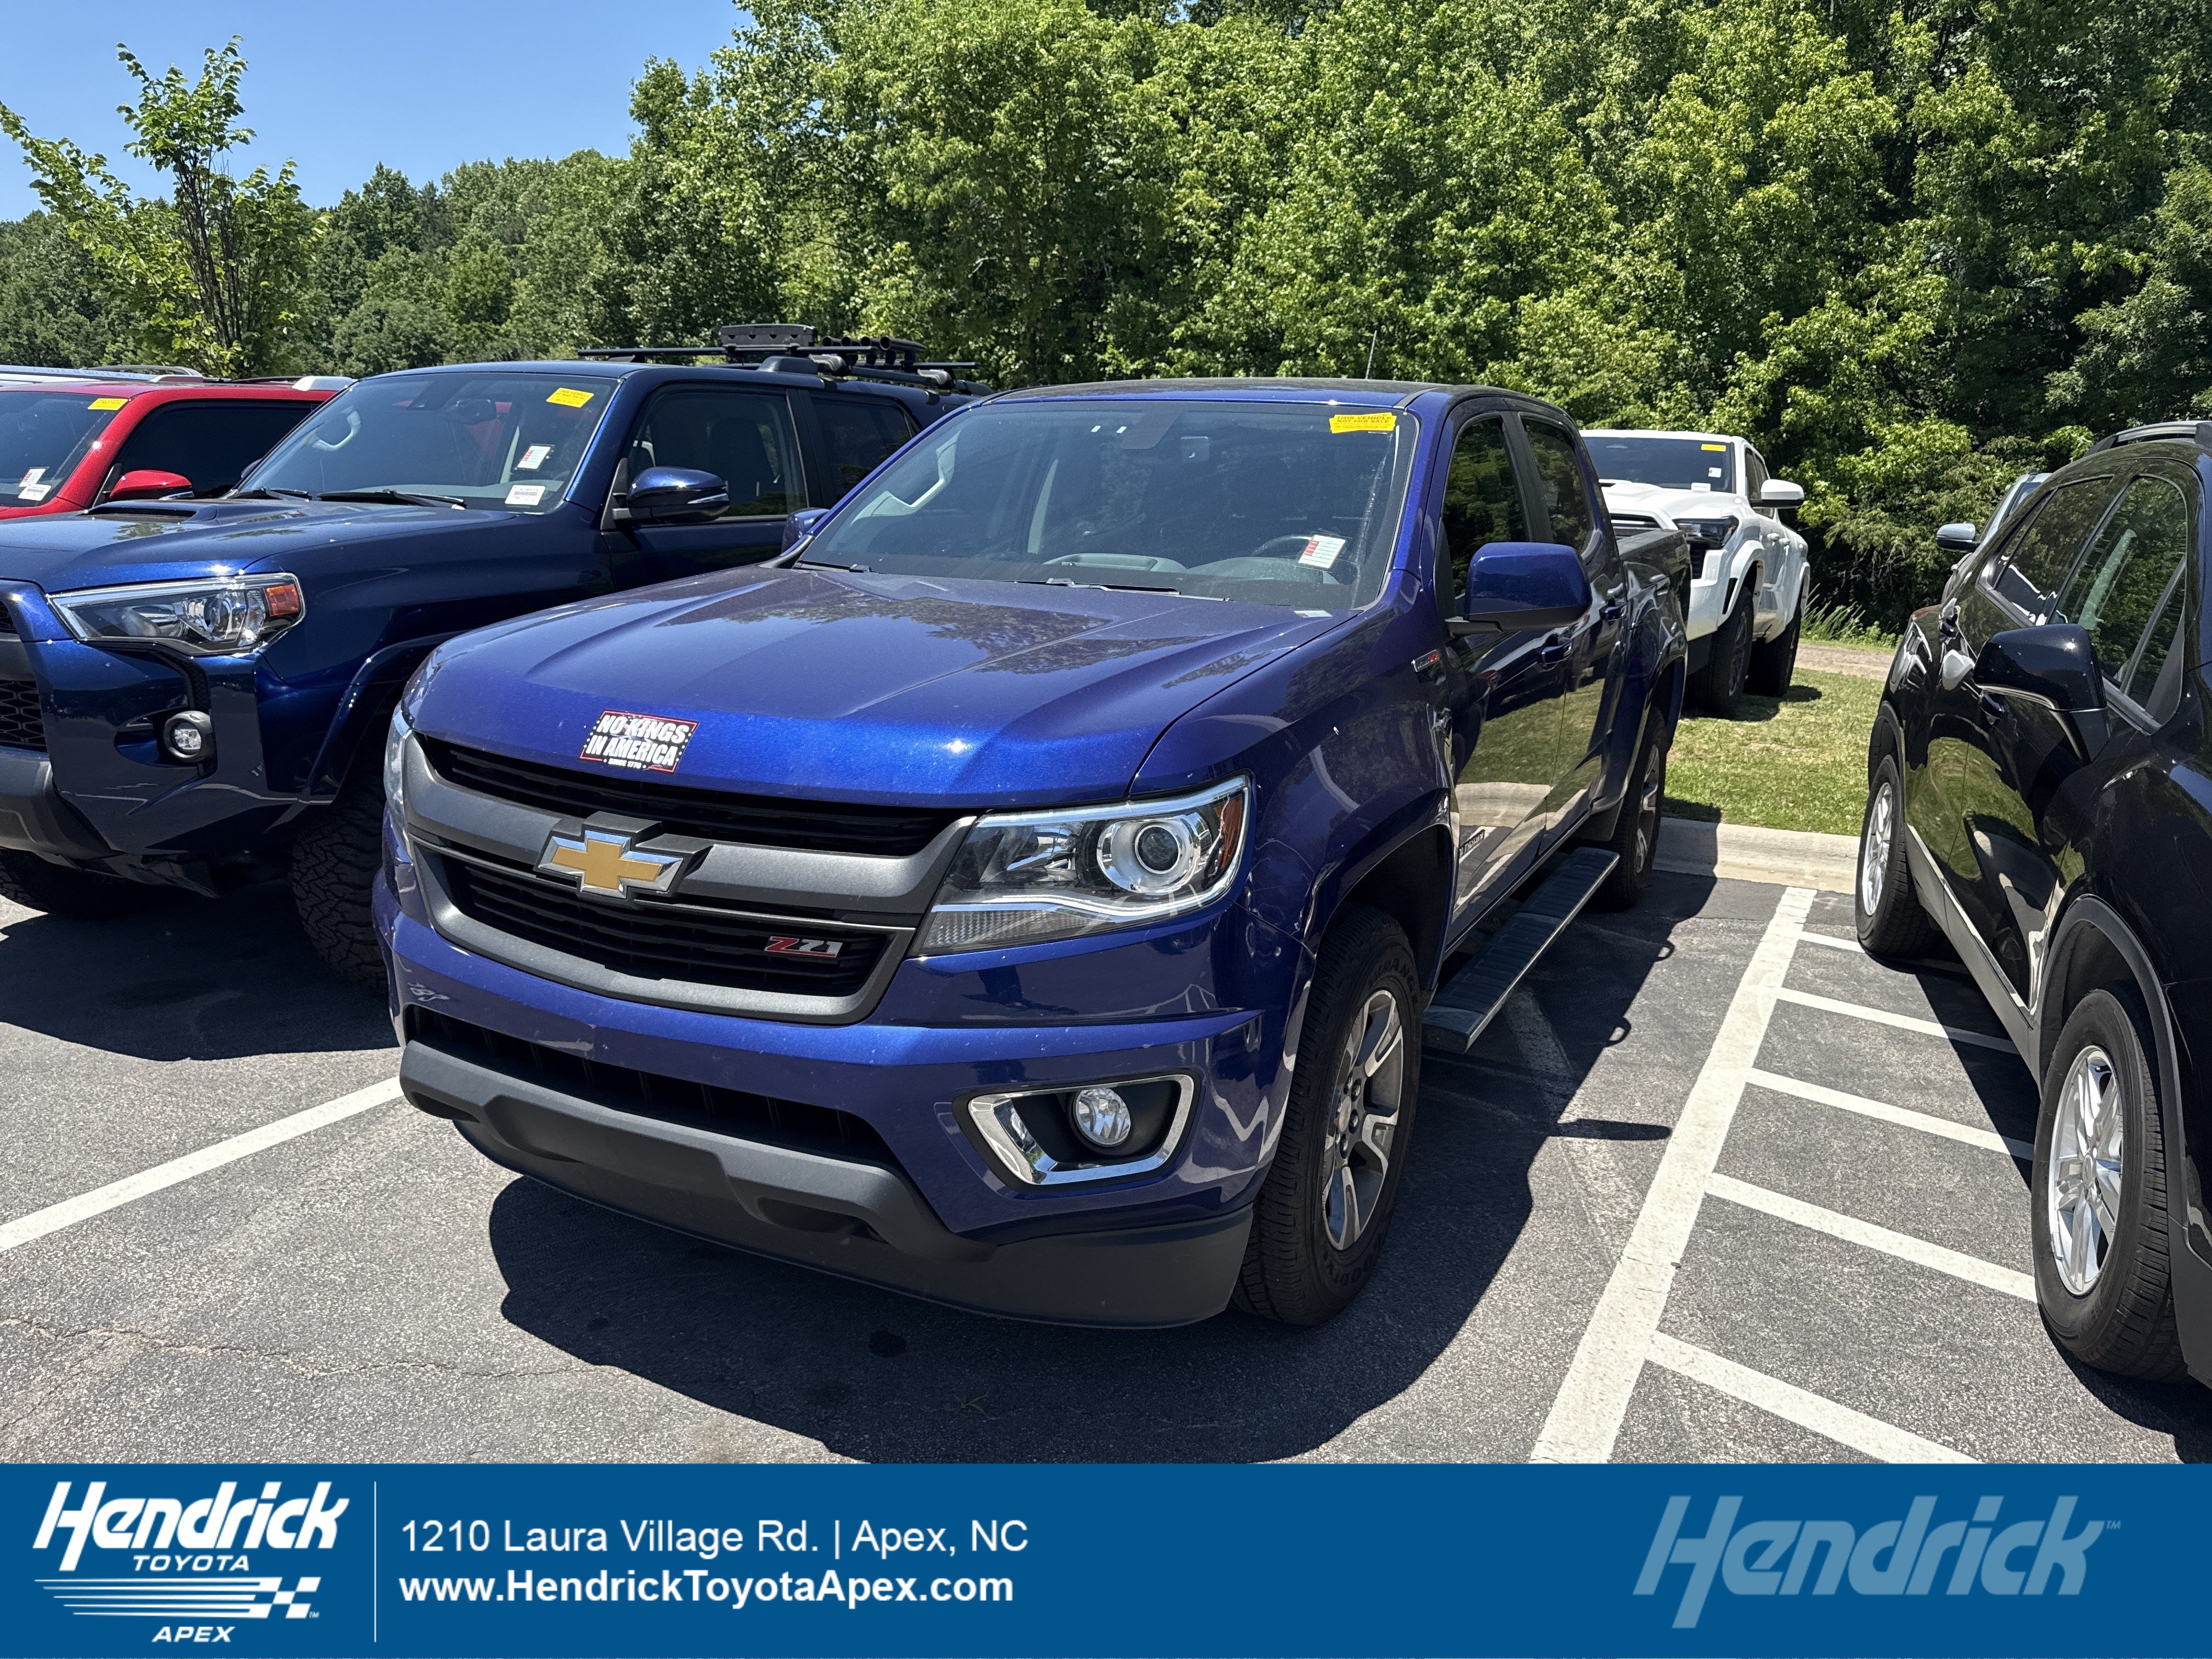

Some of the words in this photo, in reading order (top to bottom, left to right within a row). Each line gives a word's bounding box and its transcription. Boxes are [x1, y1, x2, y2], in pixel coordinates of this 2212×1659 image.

[596, 715, 628, 735] NO
[624, 718, 690, 744] KINGS
[585, 735, 608, 755] IN
[602, 737, 679, 766] AMERICA
[763, 936, 843, 958] Z71
